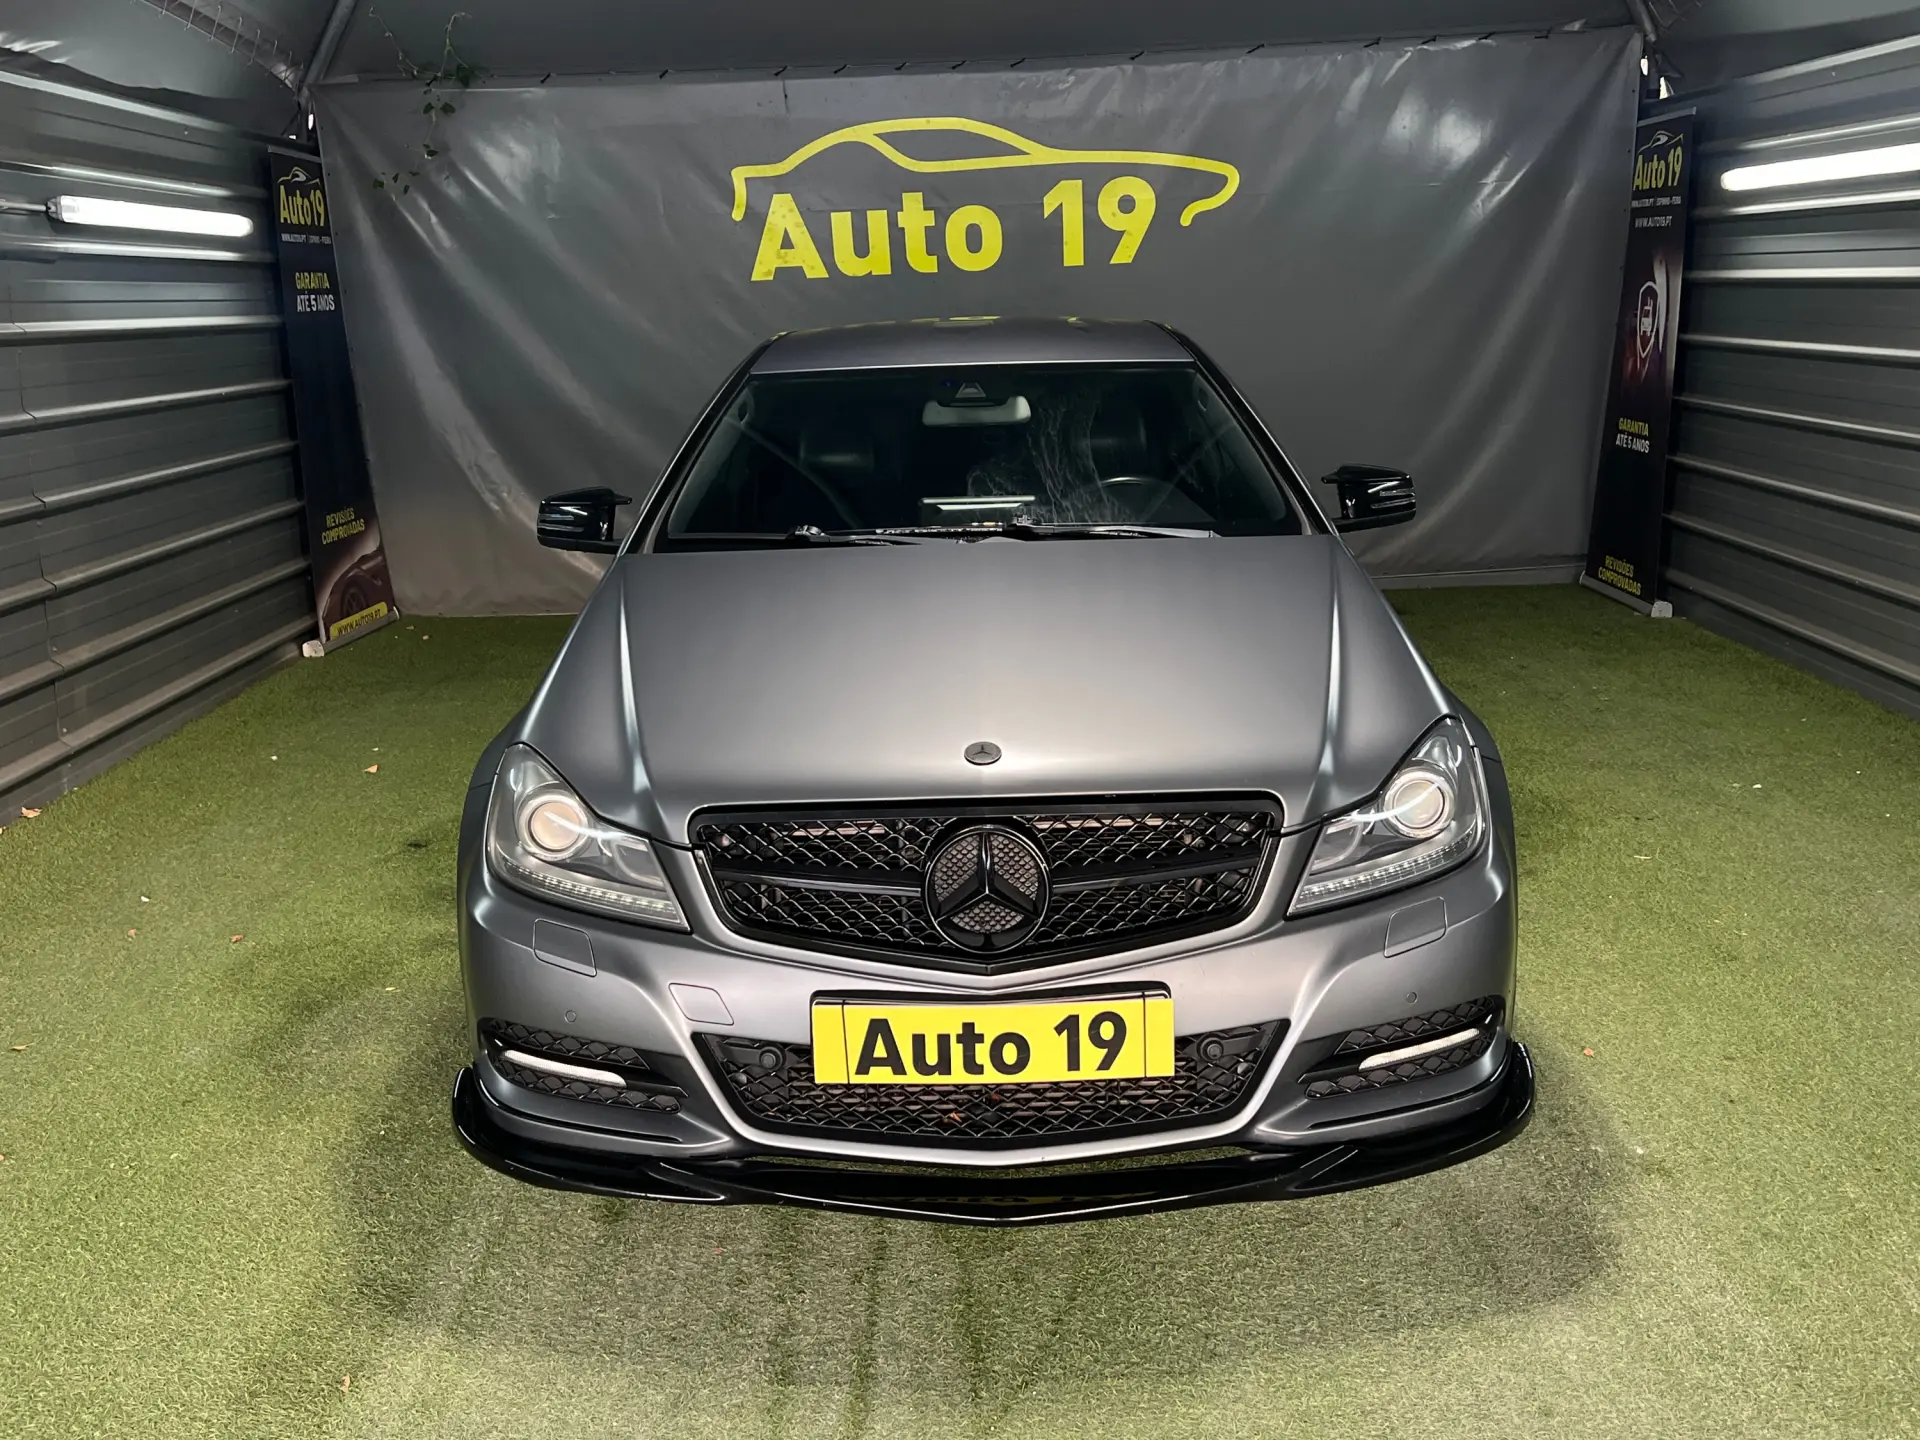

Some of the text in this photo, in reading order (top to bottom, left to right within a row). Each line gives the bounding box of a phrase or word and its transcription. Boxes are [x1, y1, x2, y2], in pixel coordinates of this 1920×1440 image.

[1633, 146, 1683, 190] Auto 19
[750, 176, 1157, 282] Auto 19
[295, 272, 330, 290] GARANTIA
[297, 291, 335, 312] ATÉ 5 ANOS
[1618, 417, 1649, 436] GARANTIA
[1615, 432, 1650, 454] ATÉ 5 ANOS
[326, 507, 354, 528] REVISÕES
[321, 519, 365, 545] COMPROVADAS
[1605, 555, 1634, 577] REVISÕES
[1598, 566, 1642, 596] COMPROVADAS
[336, 608, 381, 637] WWW.AUTO19.PT
[854, 1010, 1128, 1076] Auto 19
